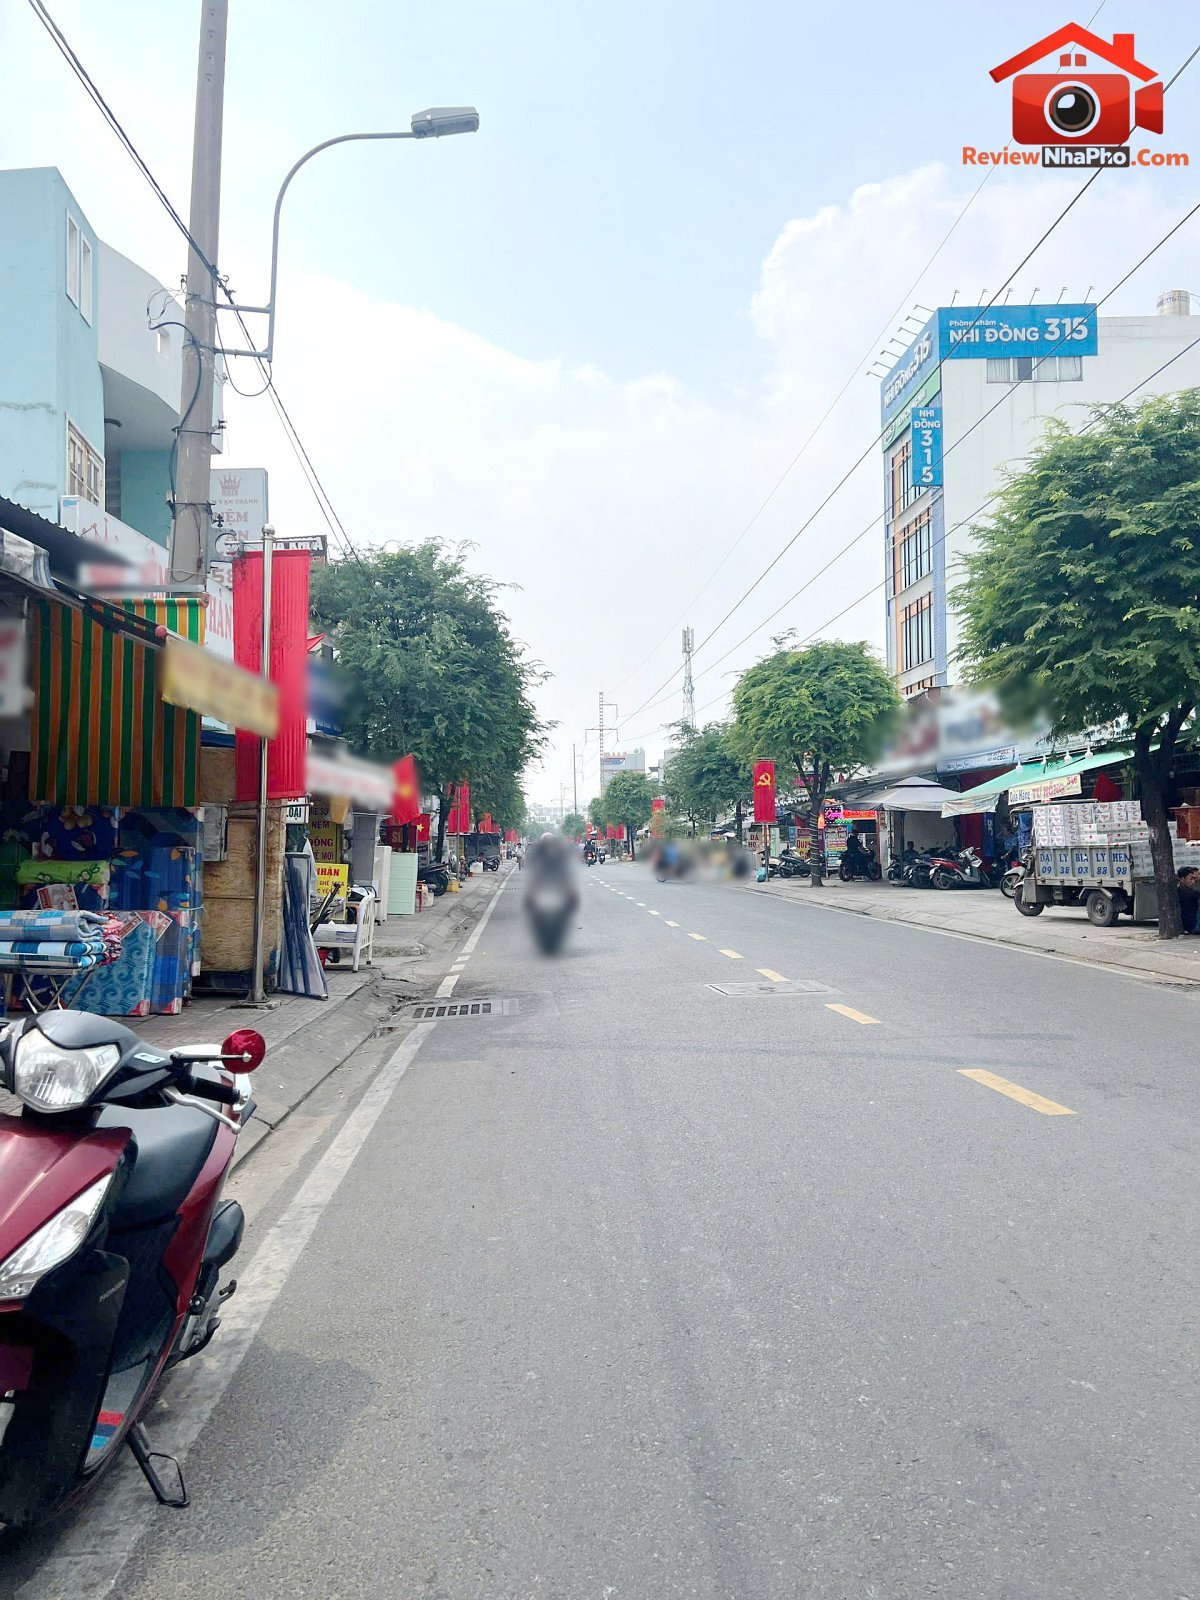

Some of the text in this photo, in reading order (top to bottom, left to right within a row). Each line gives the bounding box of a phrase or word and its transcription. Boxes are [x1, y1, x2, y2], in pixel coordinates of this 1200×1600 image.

[949, 317, 1088, 343] NHI ĐỒNG 315
[919, 409, 935, 418] NHI
[914, 418, 941, 429] ĐỒNG
[286, 807, 302, 820] OẠI
[1042, 866, 1128, 875] 09 38 03 88 98
